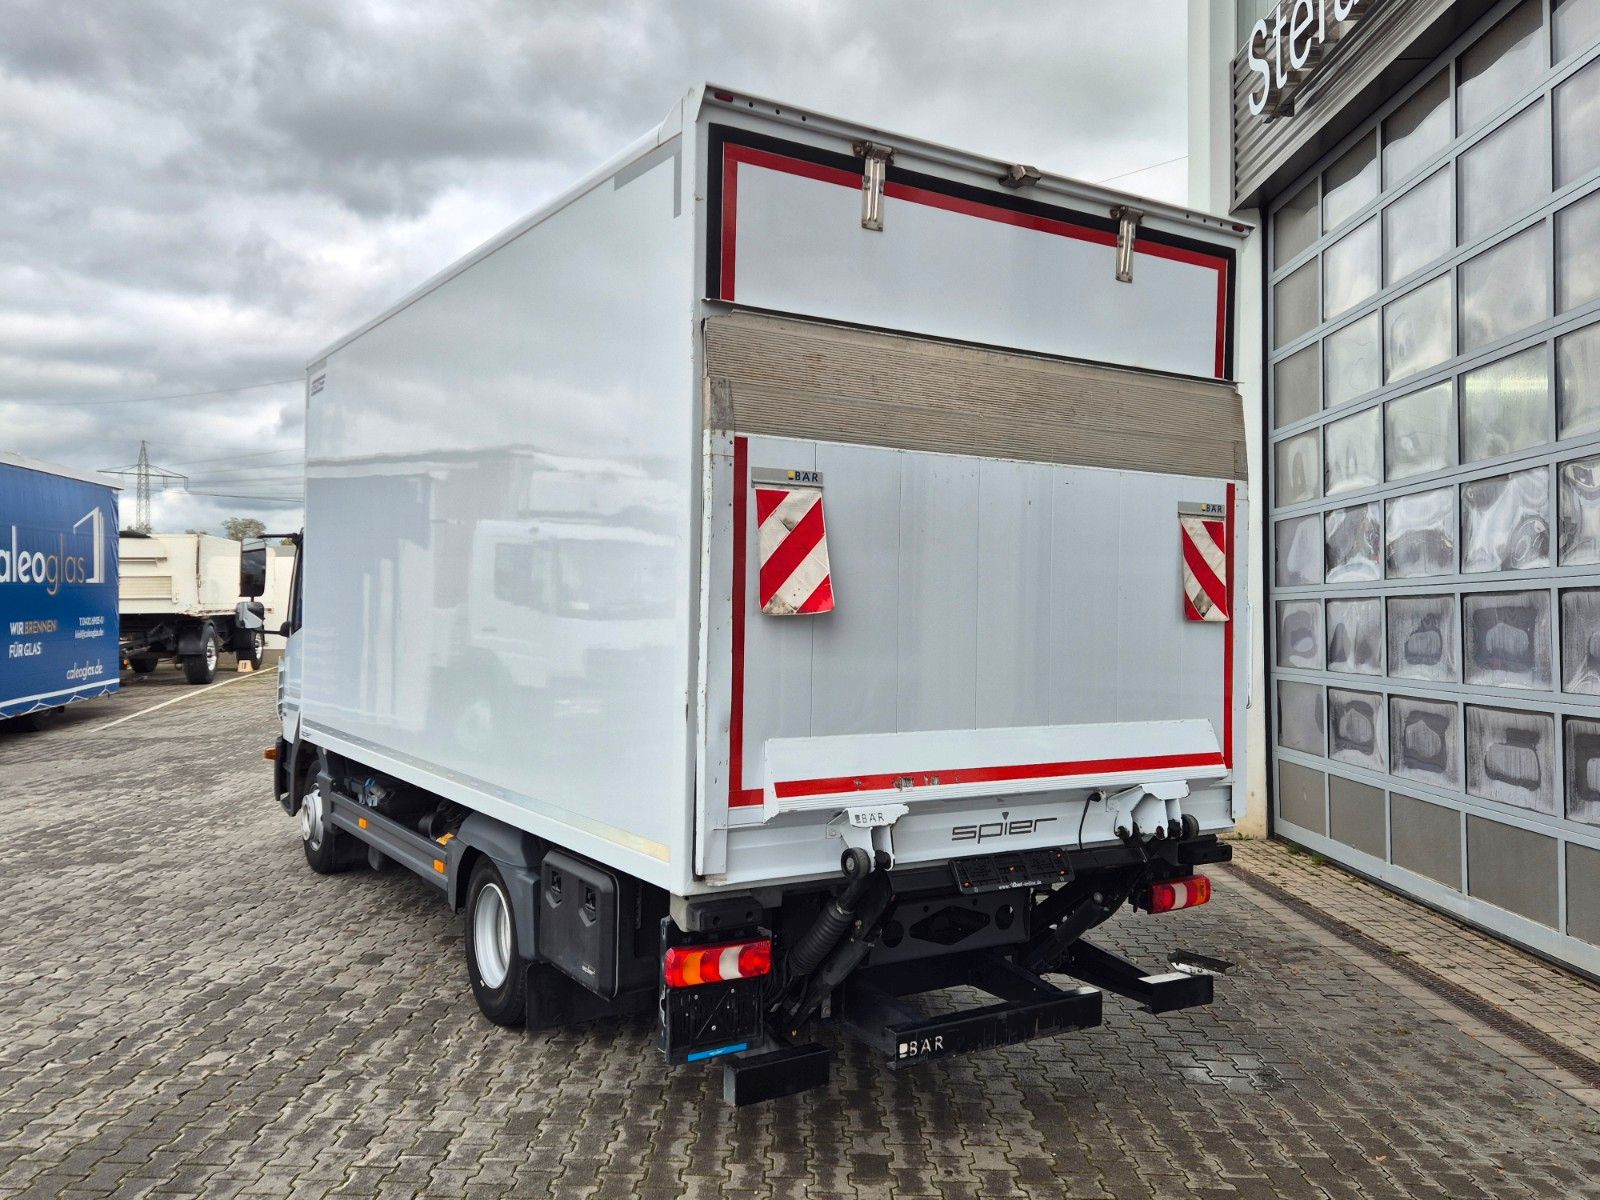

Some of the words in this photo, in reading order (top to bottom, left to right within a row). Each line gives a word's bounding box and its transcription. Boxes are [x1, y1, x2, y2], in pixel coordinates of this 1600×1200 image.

[794, 471, 819, 483] BÄR
[9, 621, 24, 636] WIR
[24, 619, 58, 635] BRENNEN
[8, 641, 24, 659] FÜR
[24, 641, 42, 656] GLAS
[66, 658, 104, 680] caleoglas.de
[951, 811, 1058, 845] spier
[909, 1035, 944, 1057] BÄR
